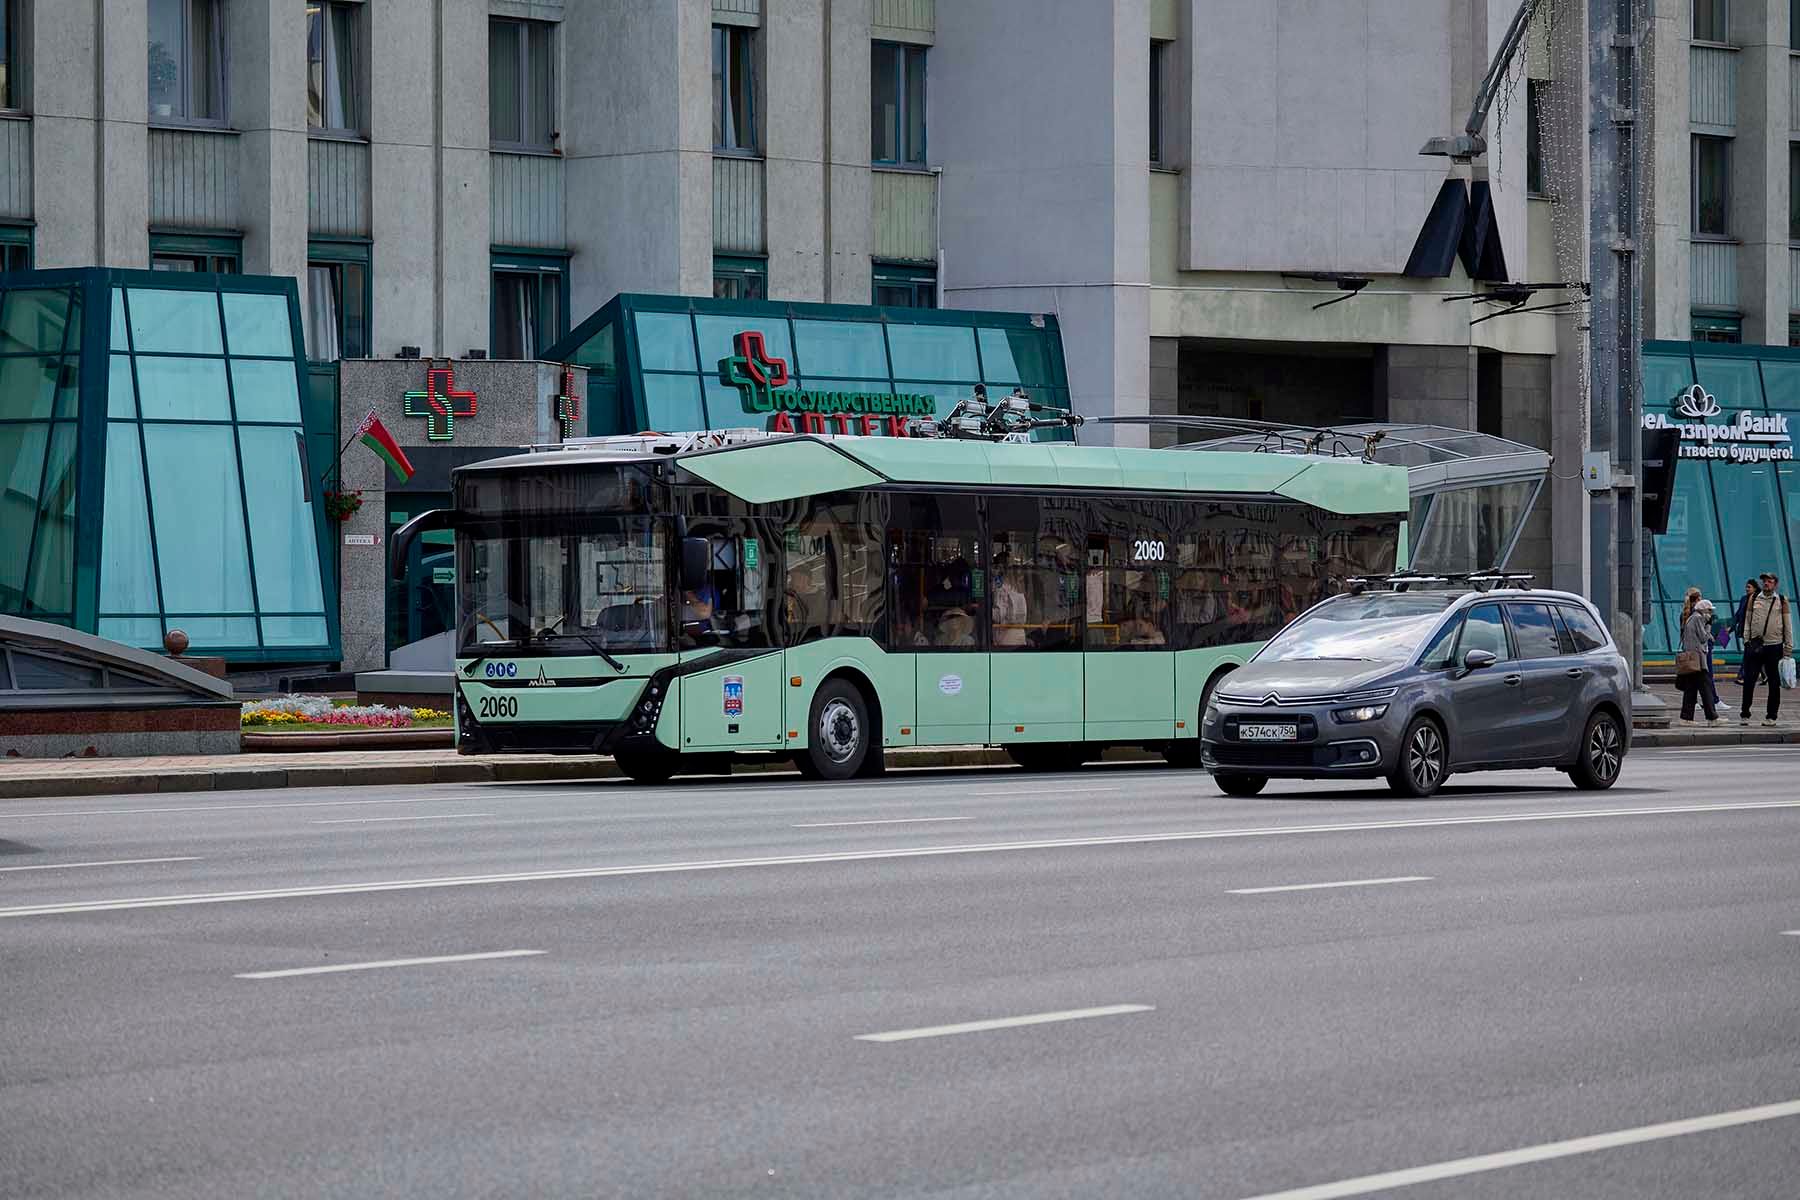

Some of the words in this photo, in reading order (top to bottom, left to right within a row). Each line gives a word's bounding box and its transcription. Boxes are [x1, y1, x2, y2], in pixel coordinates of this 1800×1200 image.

[775, 390, 936, 414] ГОСУДАРСТВЕННАЯ
[774, 411, 933, 437] АПТЕК
[1686, 446, 1728, 458] твоего
[1730, 444, 1793, 461] будущего!
[1134, 540, 1165, 561] 2060
[479, 696, 518, 718] 2060
